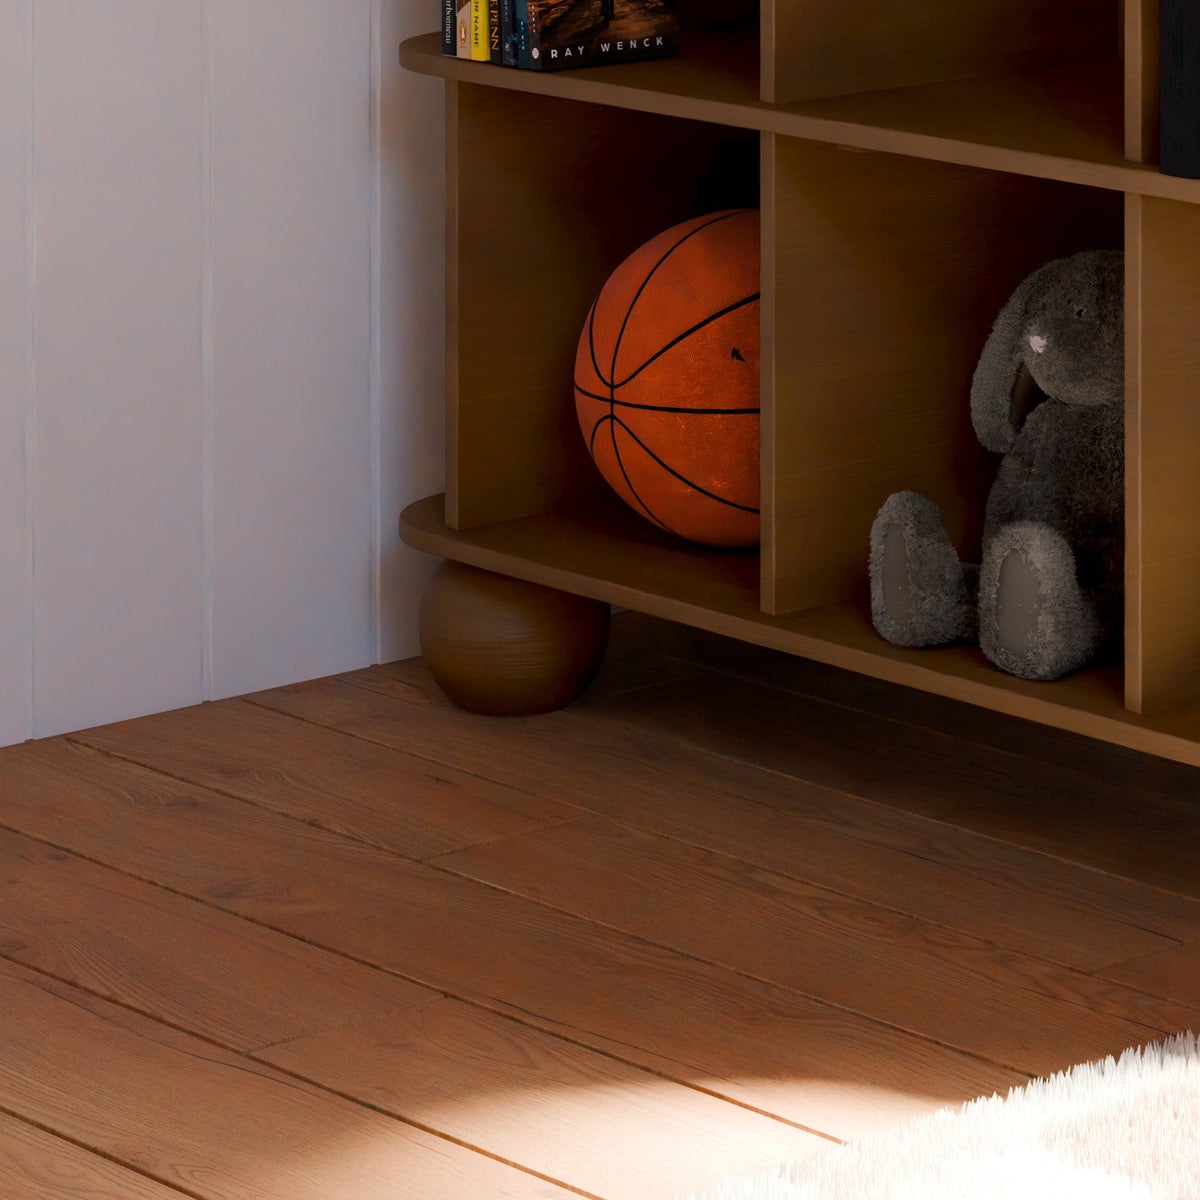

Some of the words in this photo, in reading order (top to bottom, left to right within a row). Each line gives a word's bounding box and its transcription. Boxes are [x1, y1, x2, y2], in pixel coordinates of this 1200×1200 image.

[490, 9, 500, 51] PENN
[550, 46, 586, 60] RAY
[600, 36, 664, 53] WENCK
